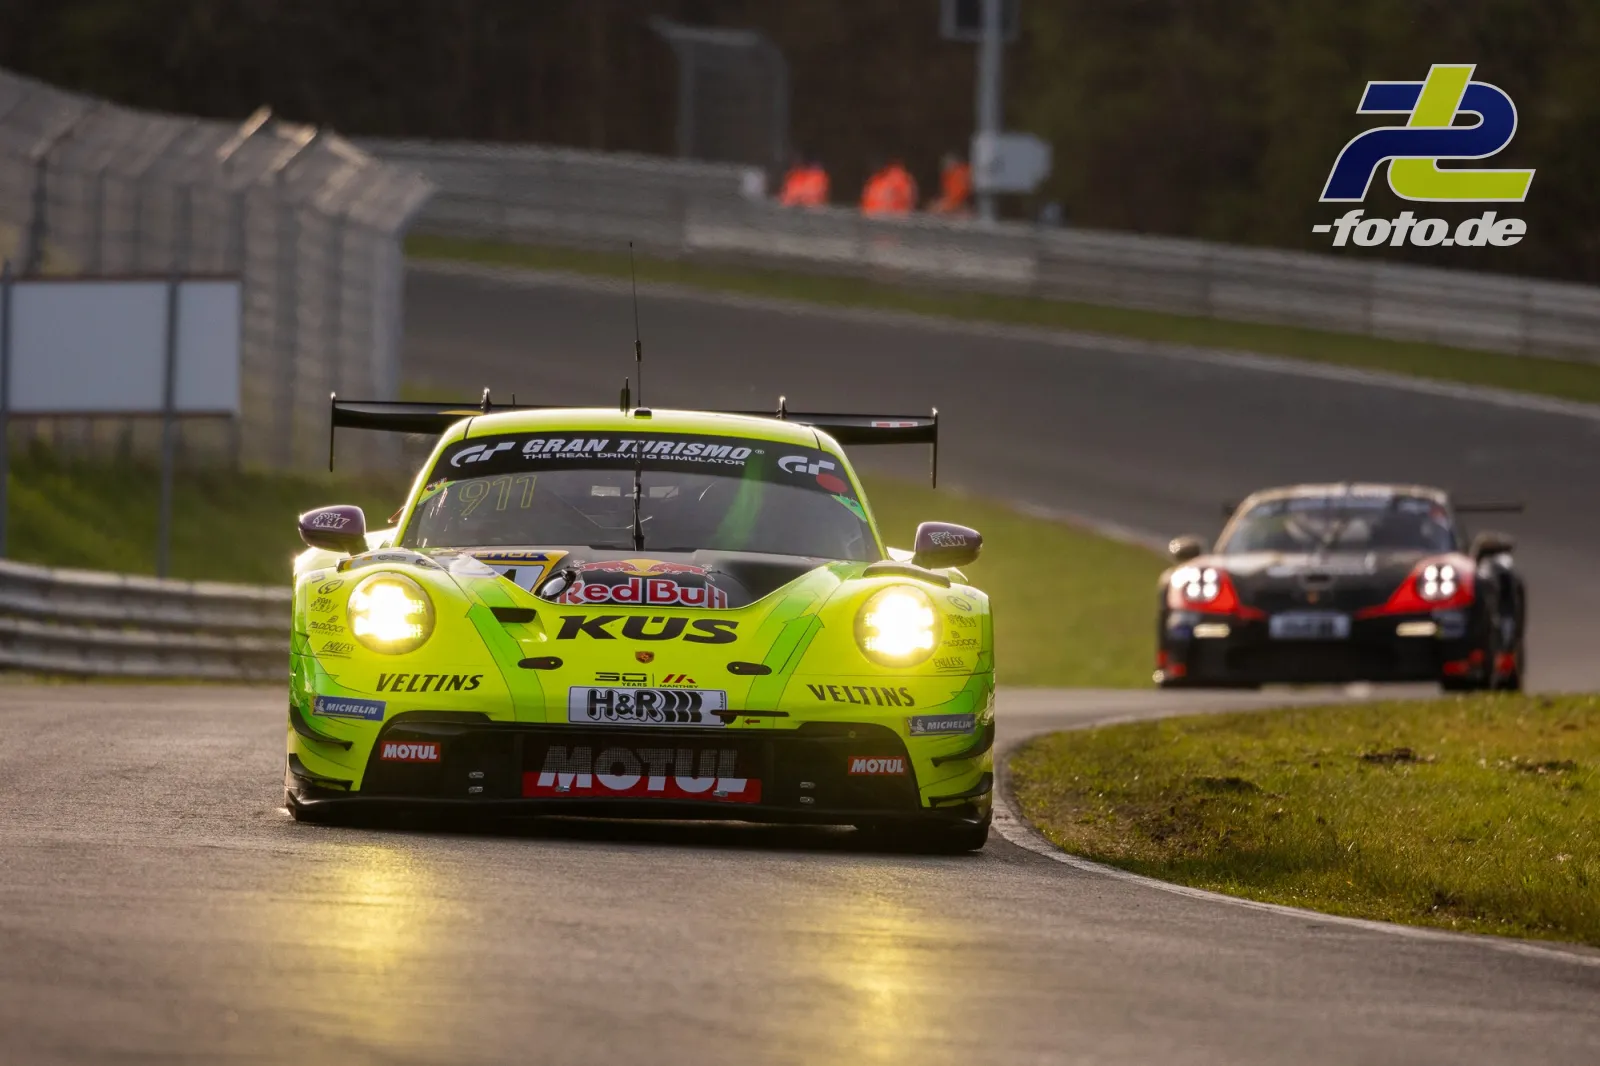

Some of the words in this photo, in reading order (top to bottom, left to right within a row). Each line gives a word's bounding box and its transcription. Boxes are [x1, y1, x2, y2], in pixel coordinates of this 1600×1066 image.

[522, 438, 610, 454] GRAN
[661, 454, 746, 466] SIMULATOR
[458, 475, 538, 516] 911
[558, 578, 643, 605] Red
[646, 579, 729, 608] Bull
[556, 615, 740, 644] KÜS
[376, 674, 484, 692] VELTINS
[594, 672, 647, 682] 30
[807, 684, 915, 707] VELTINS
[326, 702, 378, 715] MICHELIN
[587, 689, 664, 722] H&R
[927, 719, 973, 730] MICHELIN
[383, 744, 438, 759] MOTUL
[537, 745, 747, 793] MOTUL
[851, 759, 905, 773] MOTUL
